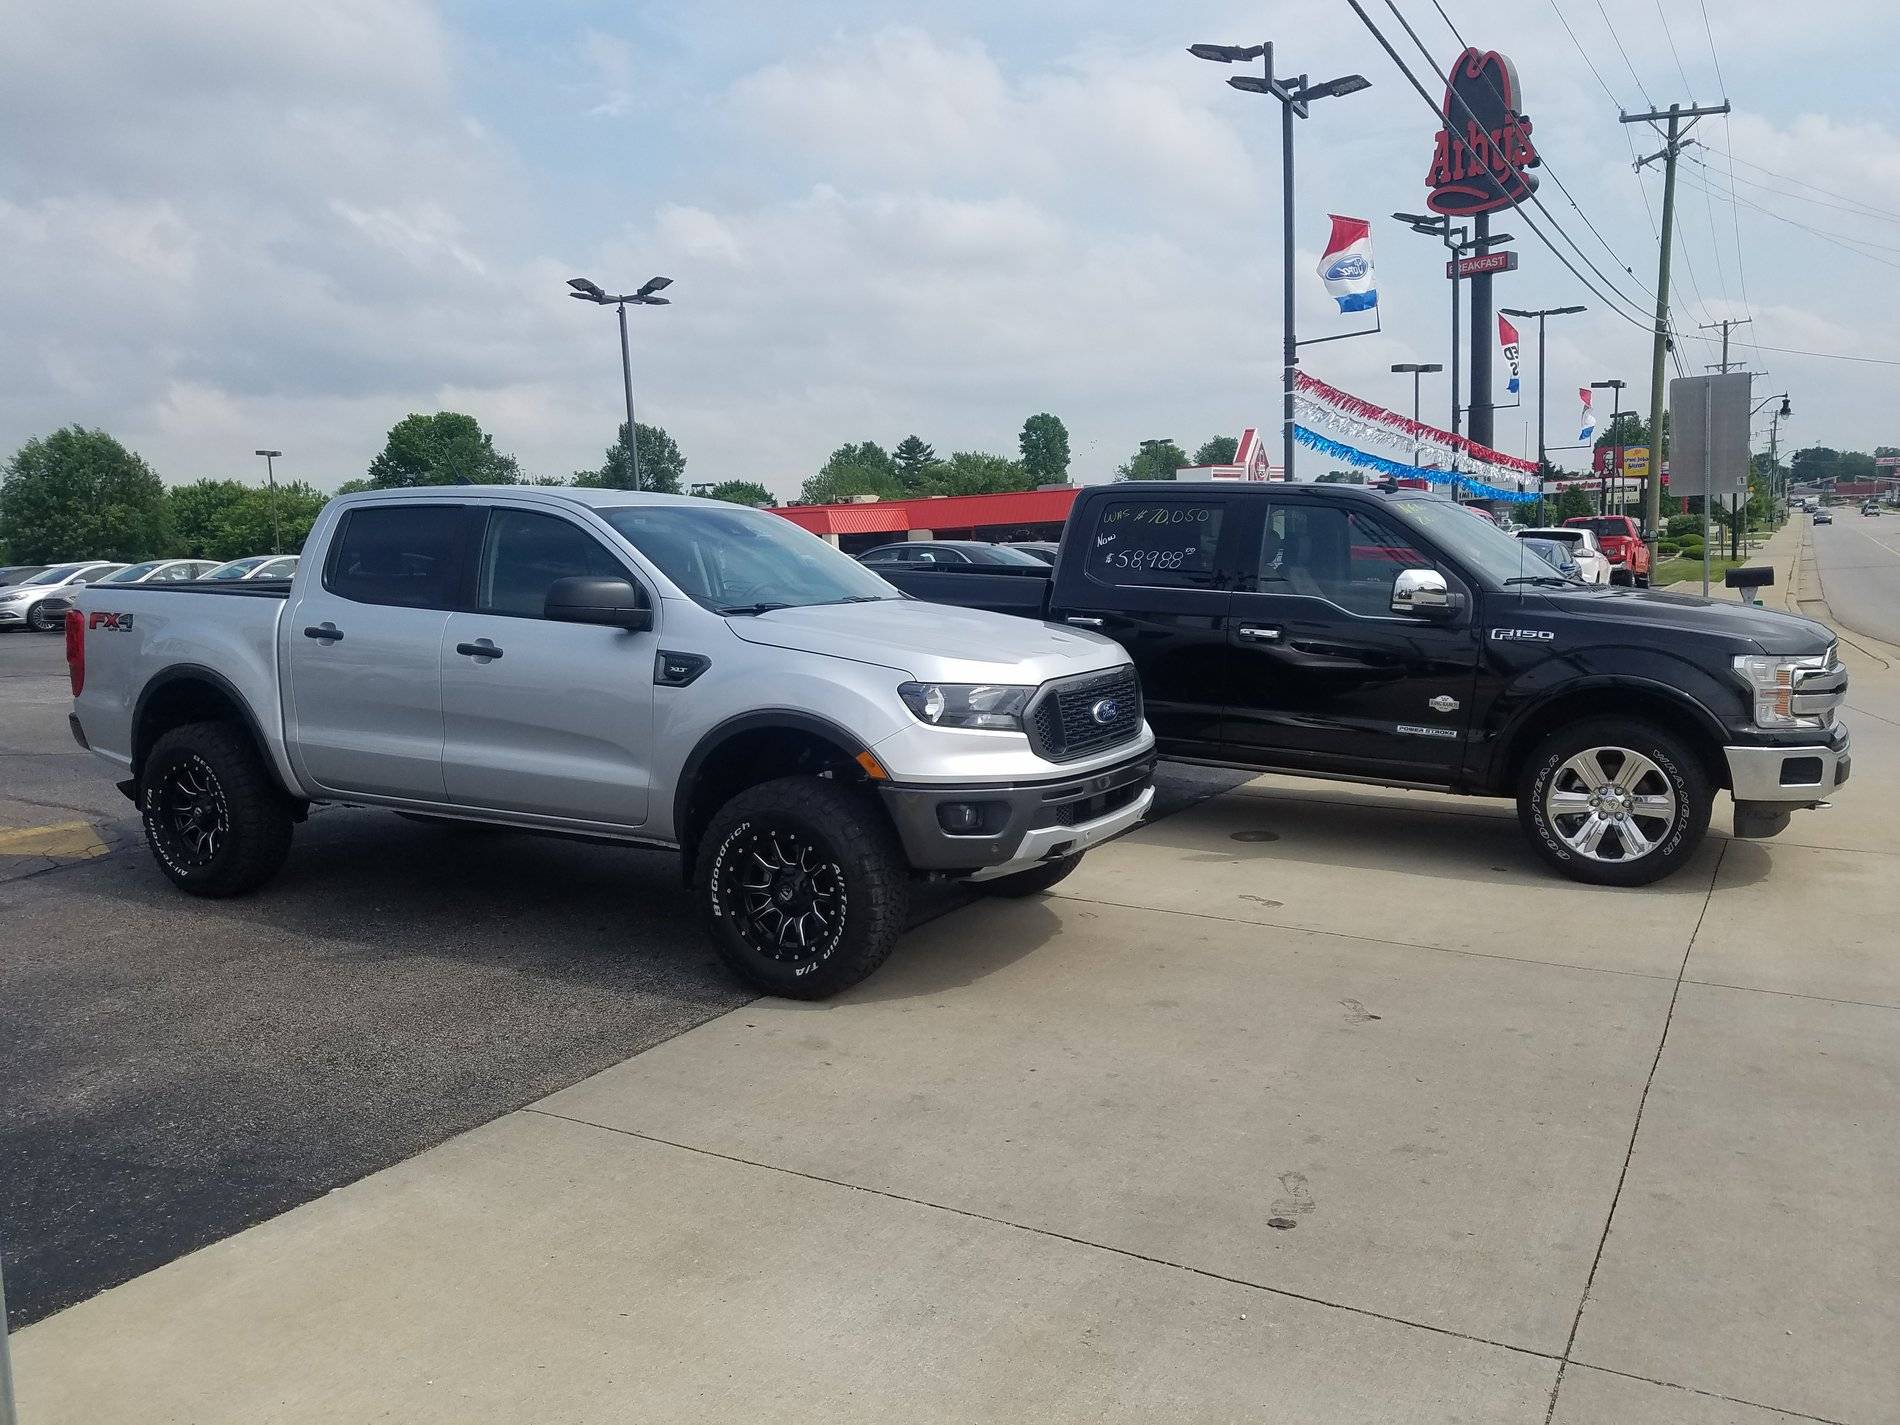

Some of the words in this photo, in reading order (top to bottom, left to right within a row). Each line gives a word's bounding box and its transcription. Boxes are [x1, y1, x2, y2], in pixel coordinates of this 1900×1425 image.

[1425, 118, 1534, 188] Arby's
[89, 612, 134, 629] FX4
[711, 822, 750, 917] BFGoodrich
